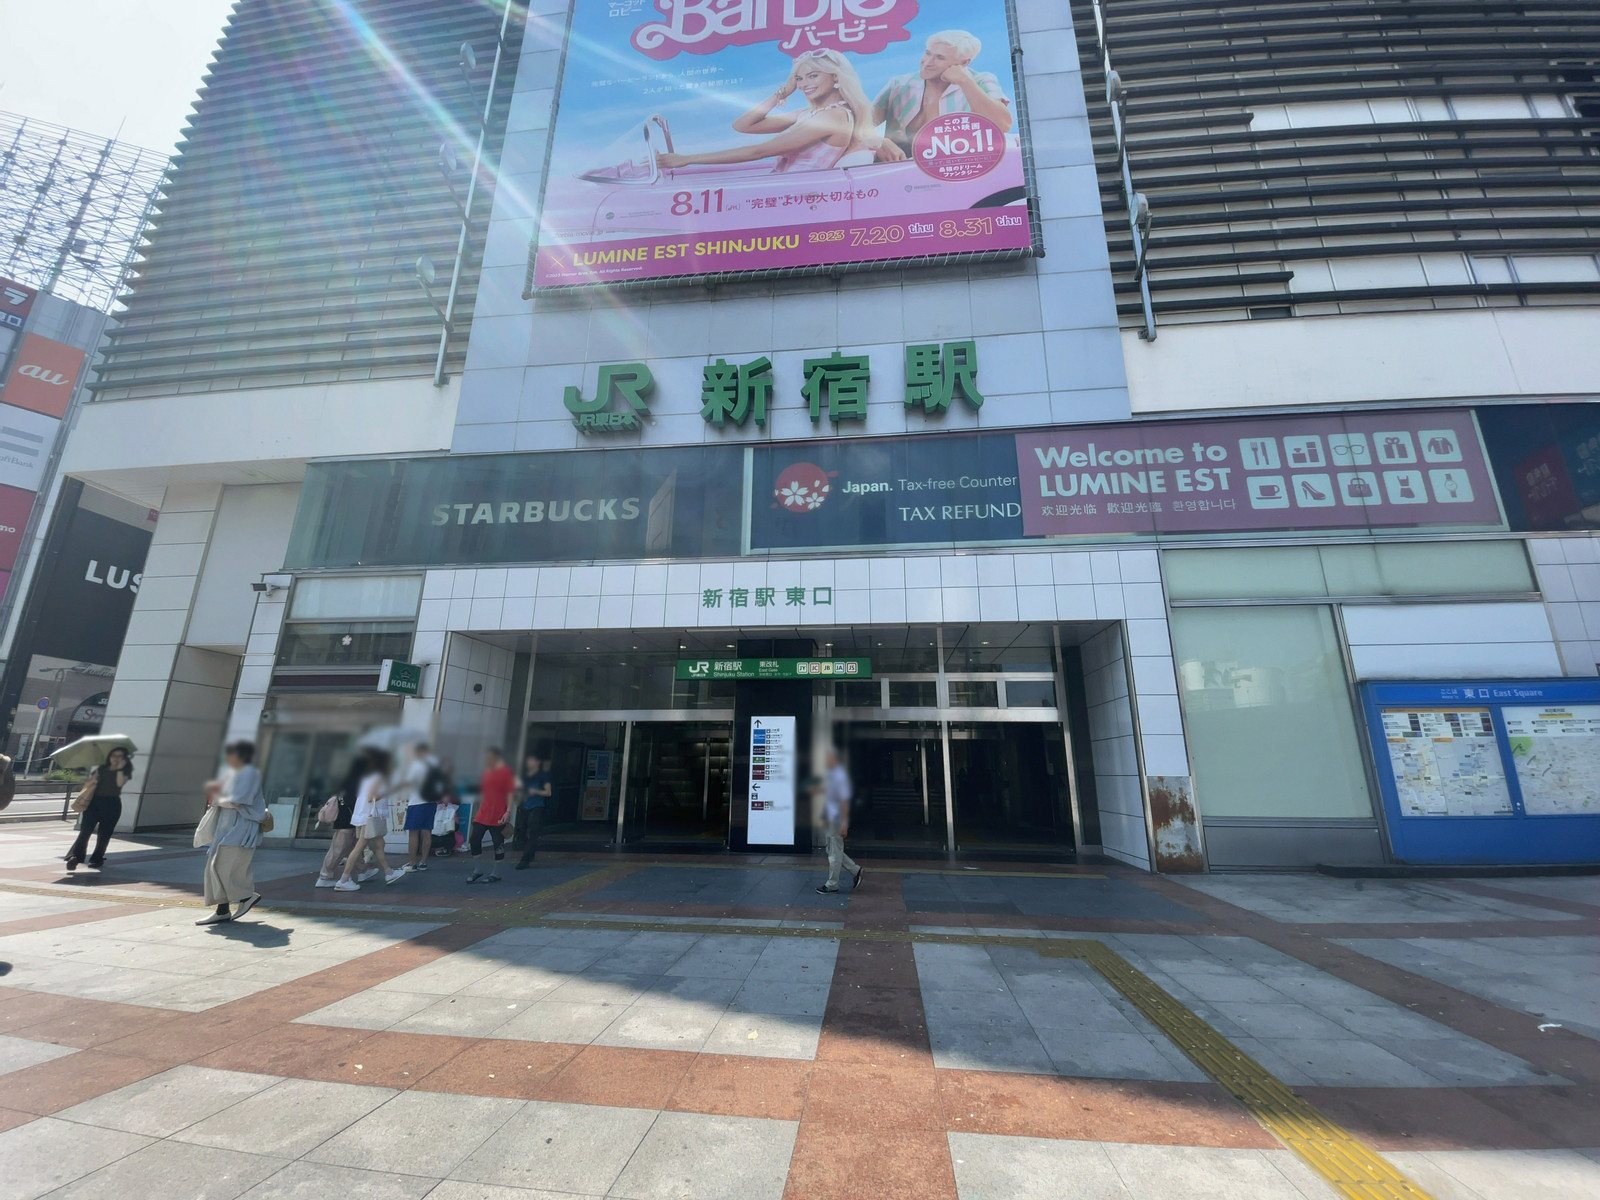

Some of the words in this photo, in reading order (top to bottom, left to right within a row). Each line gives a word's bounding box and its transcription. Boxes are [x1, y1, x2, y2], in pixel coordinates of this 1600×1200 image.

[782, 19, 888, 49] バービー
[944, 117, 970, 125] この夏
[922, 129, 994, 159] No.1!
[670, 188, 724, 216] 8.11
[572, 246, 649, 267] LUMINE
[654, 243, 690, 260] EST
[693, 234, 800, 257] SHINJUKU
[808, 229, 846, 243] 2023
[850, 224, 905, 247] 7.20
[908, 222, 934, 234] thu
[938, 216, 994, 239] 8.31
[995, 215, 1022, 227] thu
[18, 364, 69, 385] au
[563, 363, 655, 415] JR
[701, 340, 984, 428] 新宿駅
[1034, 443, 1185, 469] Welcome
[1191, 442, 1228, 463] to
[842, 480, 893, 496] Japan.
[898, 477, 956, 491] Tax-free
[959, 475, 1018, 490] Counter
[1039, 470, 1167, 498] LUMINE
[1175, 467, 1231, 493] EST
[431, 497, 640, 527] STARBUCKS
[898, 506, 936, 522] TAX
[942, 502, 1022, 520] REFUND
[1041, 503, 1097, 517] 欢迎光临
[1171, 498, 1237, 513] 환영합니다
[702, 586, 833, 609] 新宿駅東口
[689, 661, 709, 673] JR
[713, 661, 742, 671] 新宿駅
[713, 671, 736, 679] Shinjuku
[811, 664, 819, 672] JC
[823, 664, 831, 672] JB
[835, 664, 844, 672] JA
[848, 664, 856, 672] JS
[390, 679, 417, 690] KOBAN
[1463, 688, 1490, 699] 東口
[1493, 689, 1511, 697] East
[1513, 688, 1543, 699] Square
